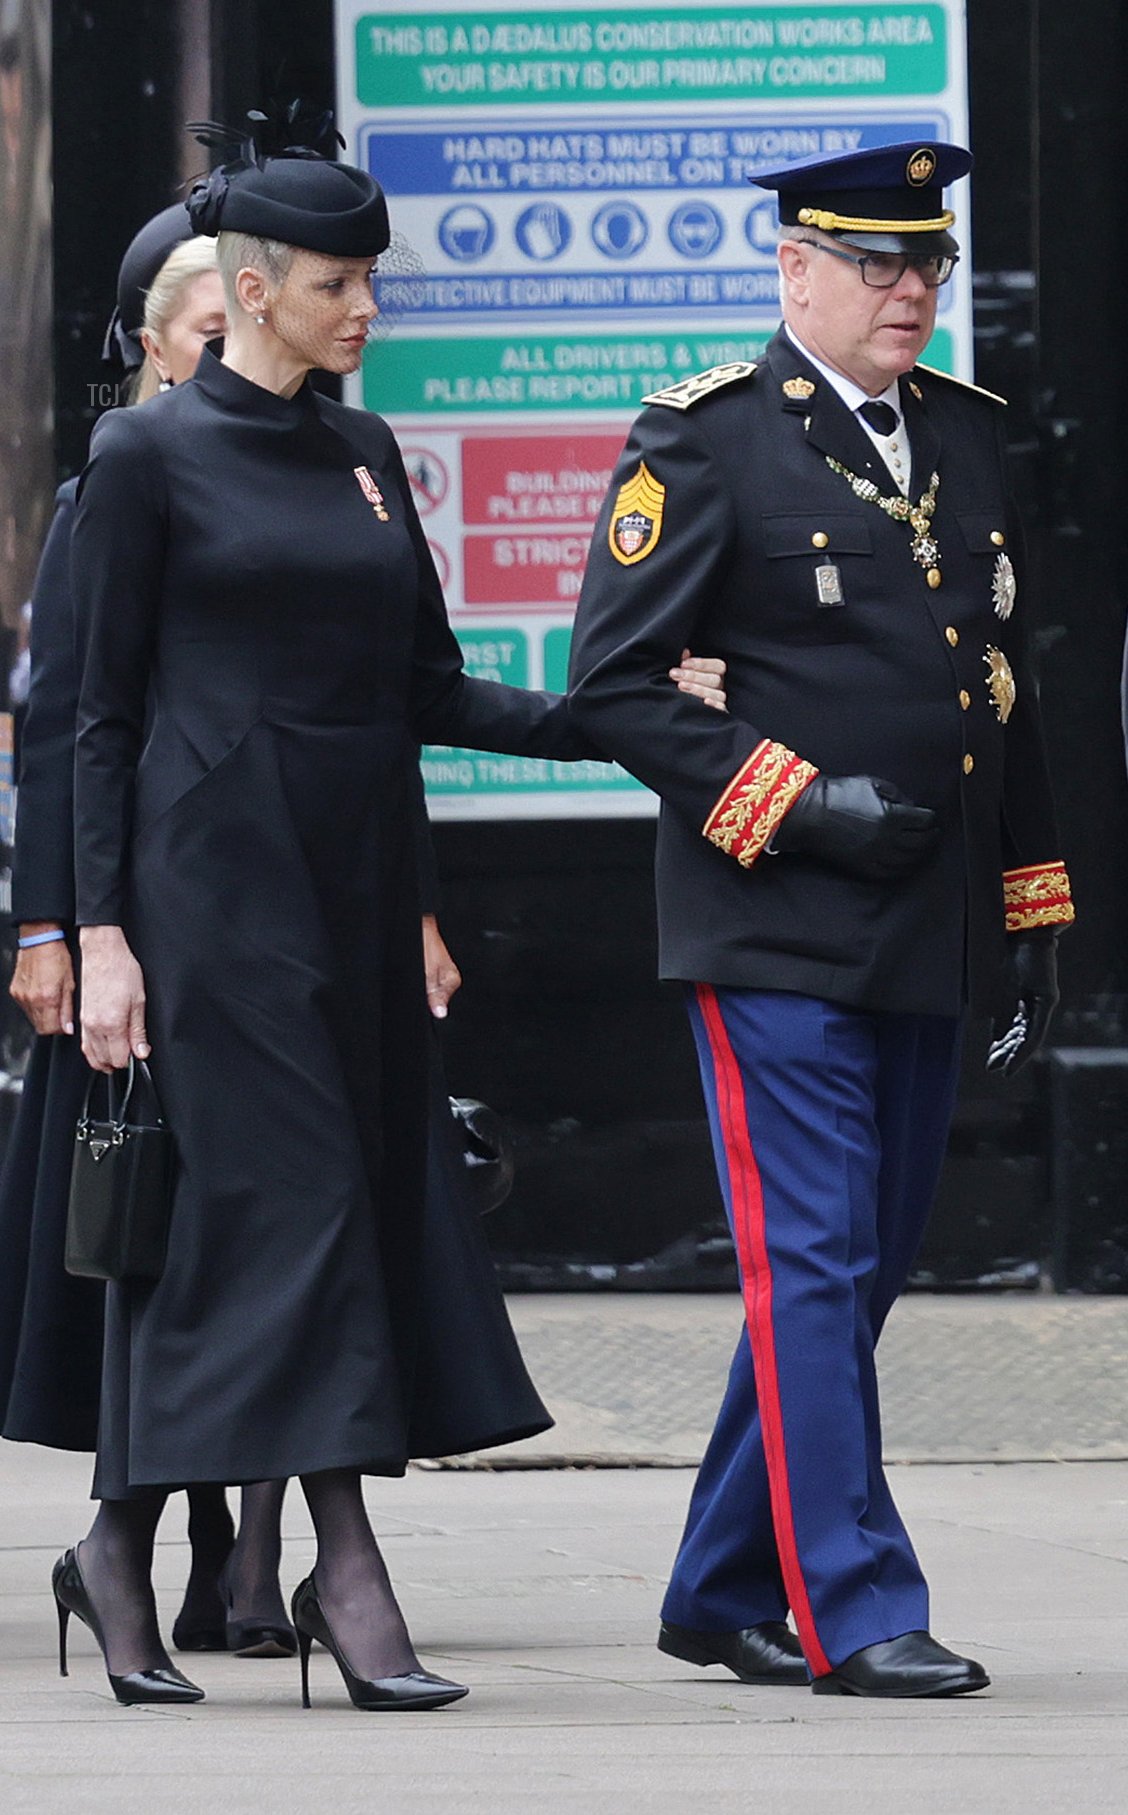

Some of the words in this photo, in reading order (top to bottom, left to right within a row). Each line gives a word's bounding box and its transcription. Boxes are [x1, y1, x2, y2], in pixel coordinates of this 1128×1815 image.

[371, 26, 423, 56] THIS
[424, 26, 449, 54] IS
[452, 24, 470, 54] A
[594, 20, 775, 52] CONSERVATION
[776, 17, 865, 48] WORKS
[866, 15, 934, 47] AREA
[420, 63, 486, 93] YOUR
[487, 61, 580, 92] SAFETY
[581, 60, 607, 90] IS
[608, 58, 660, 90] OUR
[661, 56, 768, 88] PRIMARY
[768, 54, 886, 85] CONCERN
[442, 136, 525, 162] HARD
[527, 134, 605, 161] HATS
[606, 131, 687, 159] MUST
[688, 130, 730, 157] BE
[730, 129, 820, 156] WORN
[822, 128, 863, 152] BY
[452, 162, 507, 188] ALL
[508, 158, 677, 188] PERSONNEL
[678, 156, 725, 184] ON
[510, 276, 625, 306] EQUIPMENT
[629, 274, 687, 303] MUST
[688, 274, 718, 302] BE
[501, 345, 550, 370] ALL
[553, 343, 667, 369] DRIVERS
[672, 342, 693, 368] &
[424, 376, 522, 402] PLEASE
[529, 374, 634, 399] REPORT
[488, 495, 581, 519] PLEASE
[477, 759, 548, 783] THESE
